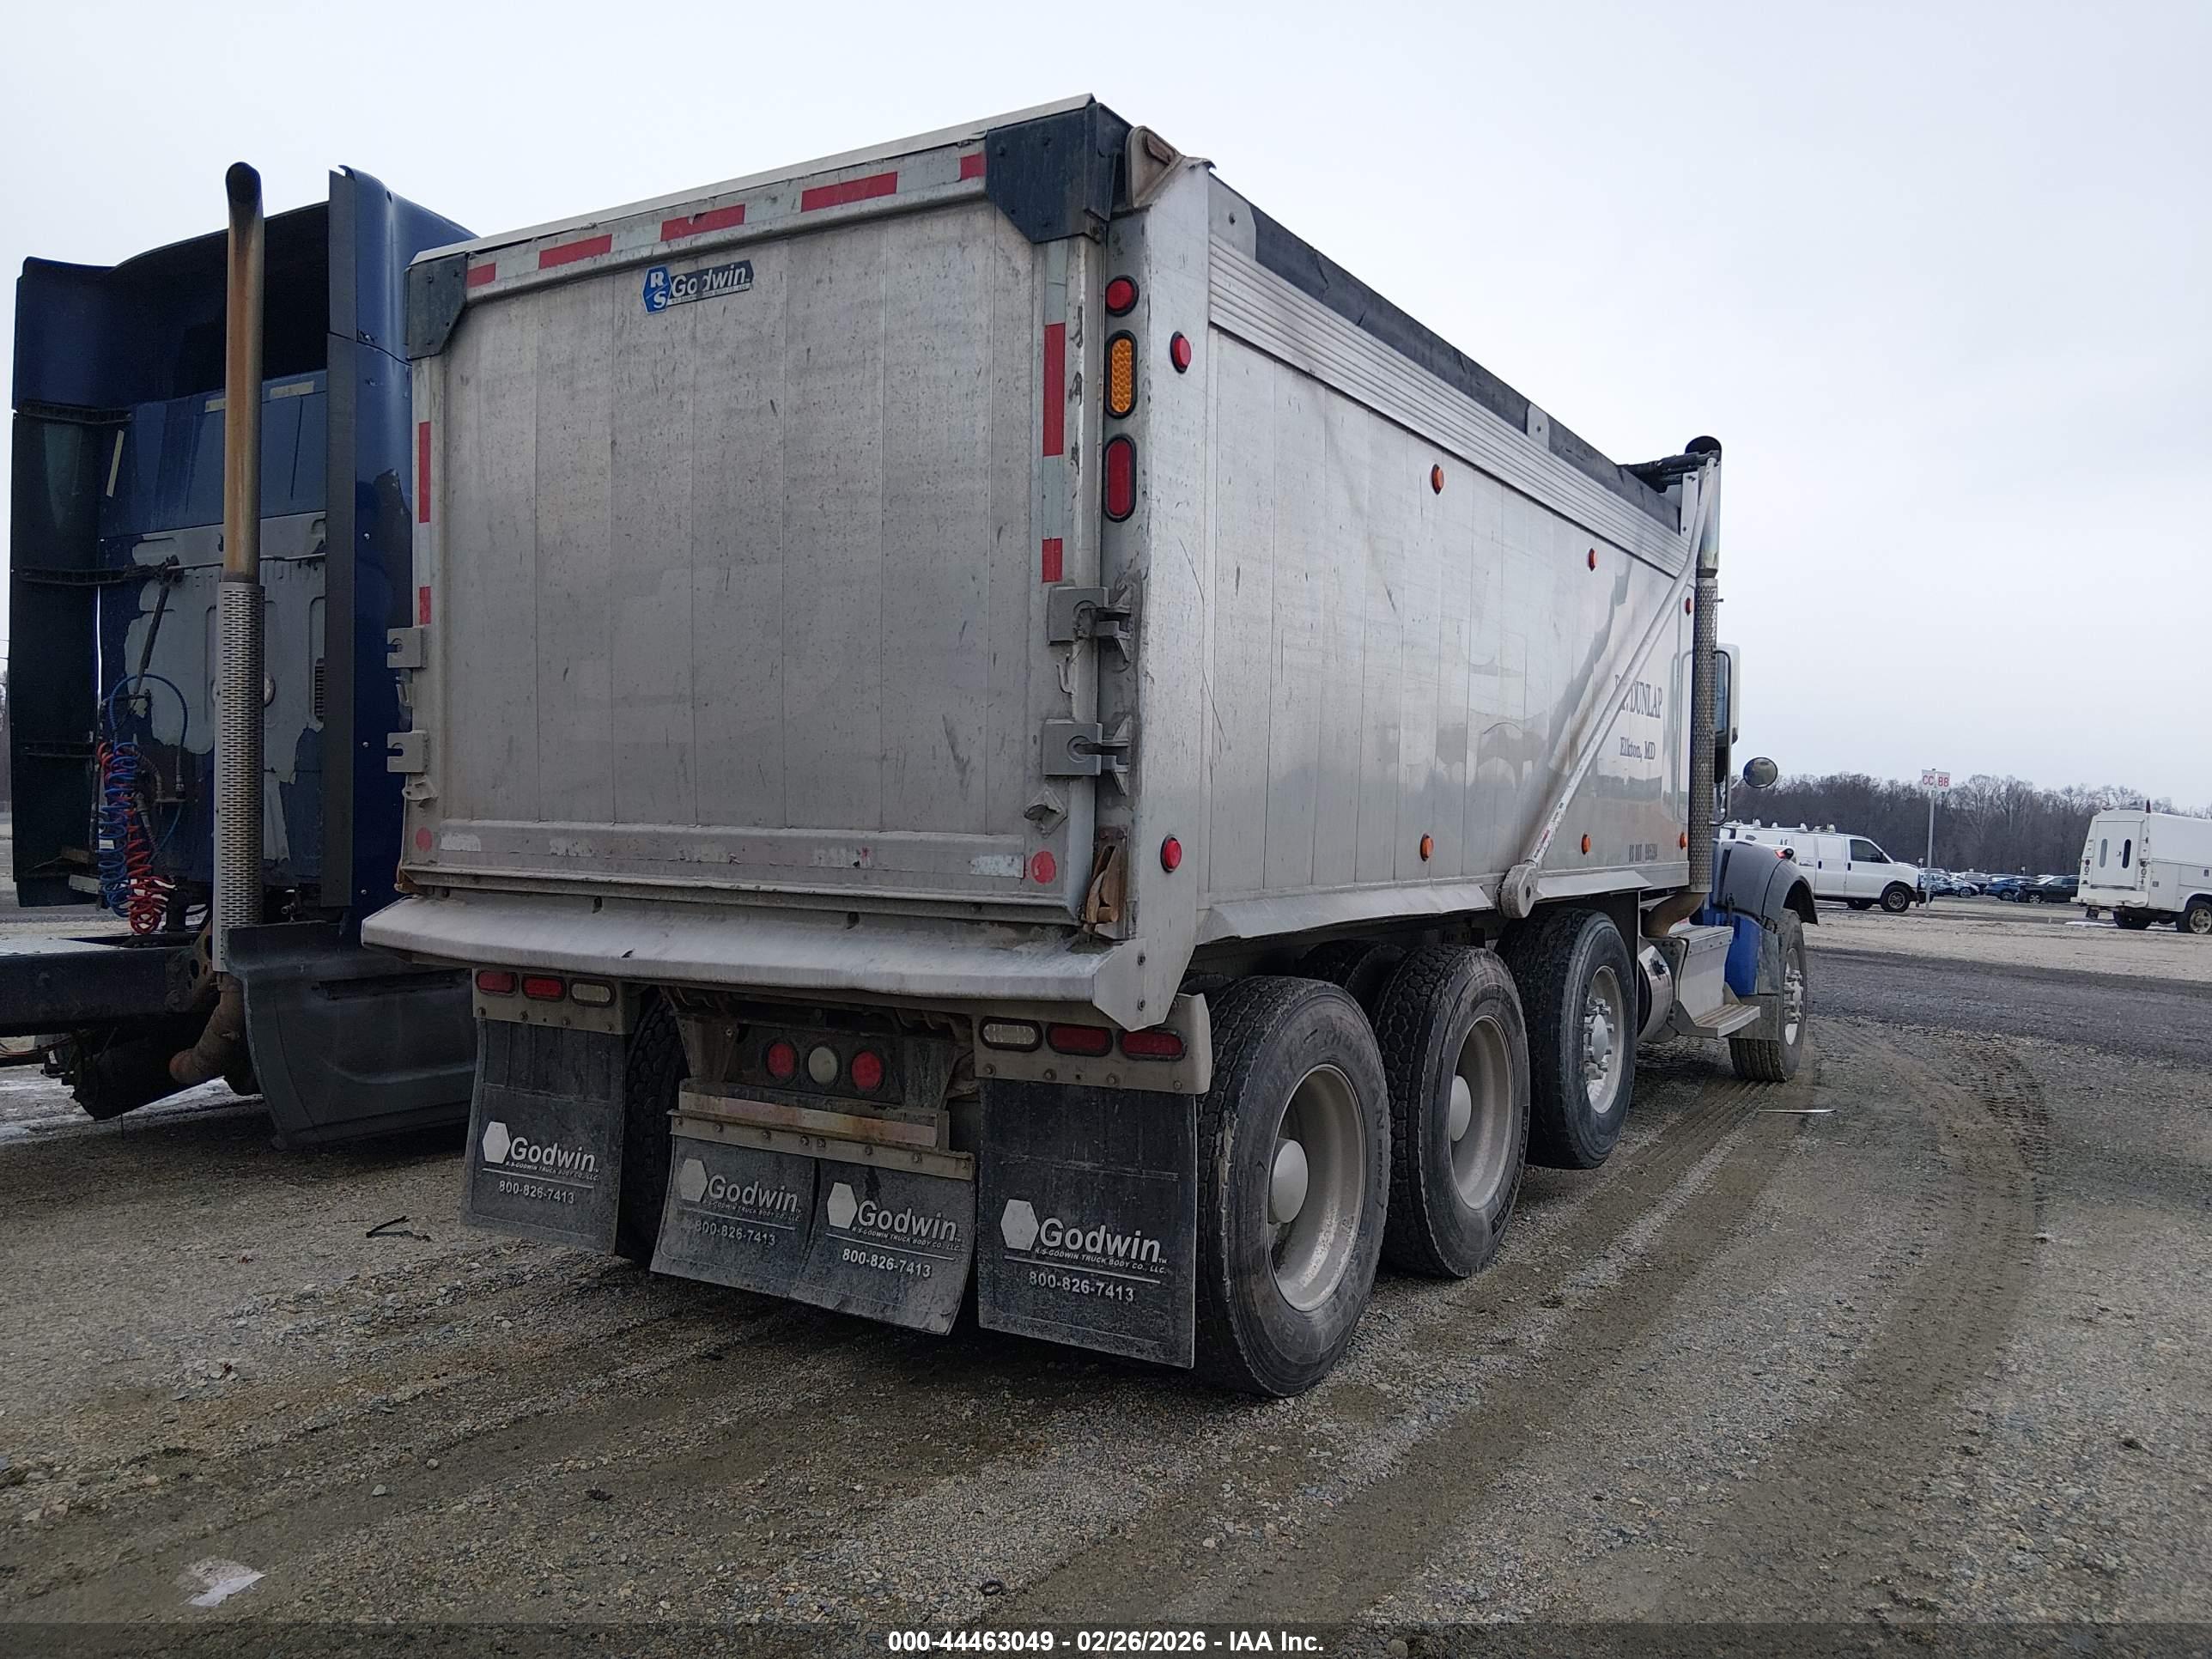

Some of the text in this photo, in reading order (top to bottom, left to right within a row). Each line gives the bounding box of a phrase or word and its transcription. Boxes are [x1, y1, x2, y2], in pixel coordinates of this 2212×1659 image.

[672, 264, 746, 298] Godwin
[1620, 737, 1656, 763] Elkton, MD
[1923, 775, 1935, 786] CC
[510, 1136, 596, 1173] Godwin
[499, 1180, 574, 1204] 800-826-7413
[708, 1174, 799, 1213] Godwin
[694, 1219, 776, 1247] 800-826-7413
[858, 1200, 957, 1243] Godwin
[1040, 1217, 1161, 1263] Godwin
[842, 1248, 932, 1278] 800-826-7413
[1048, 1249, 1079, 1260] GODWIN
[1081, 1254, 1107, 1265] TRUCK
[1109, 1258, 1130, 1268] BODY
[1030, 1271, 1134, 1302] 800-826-7413
